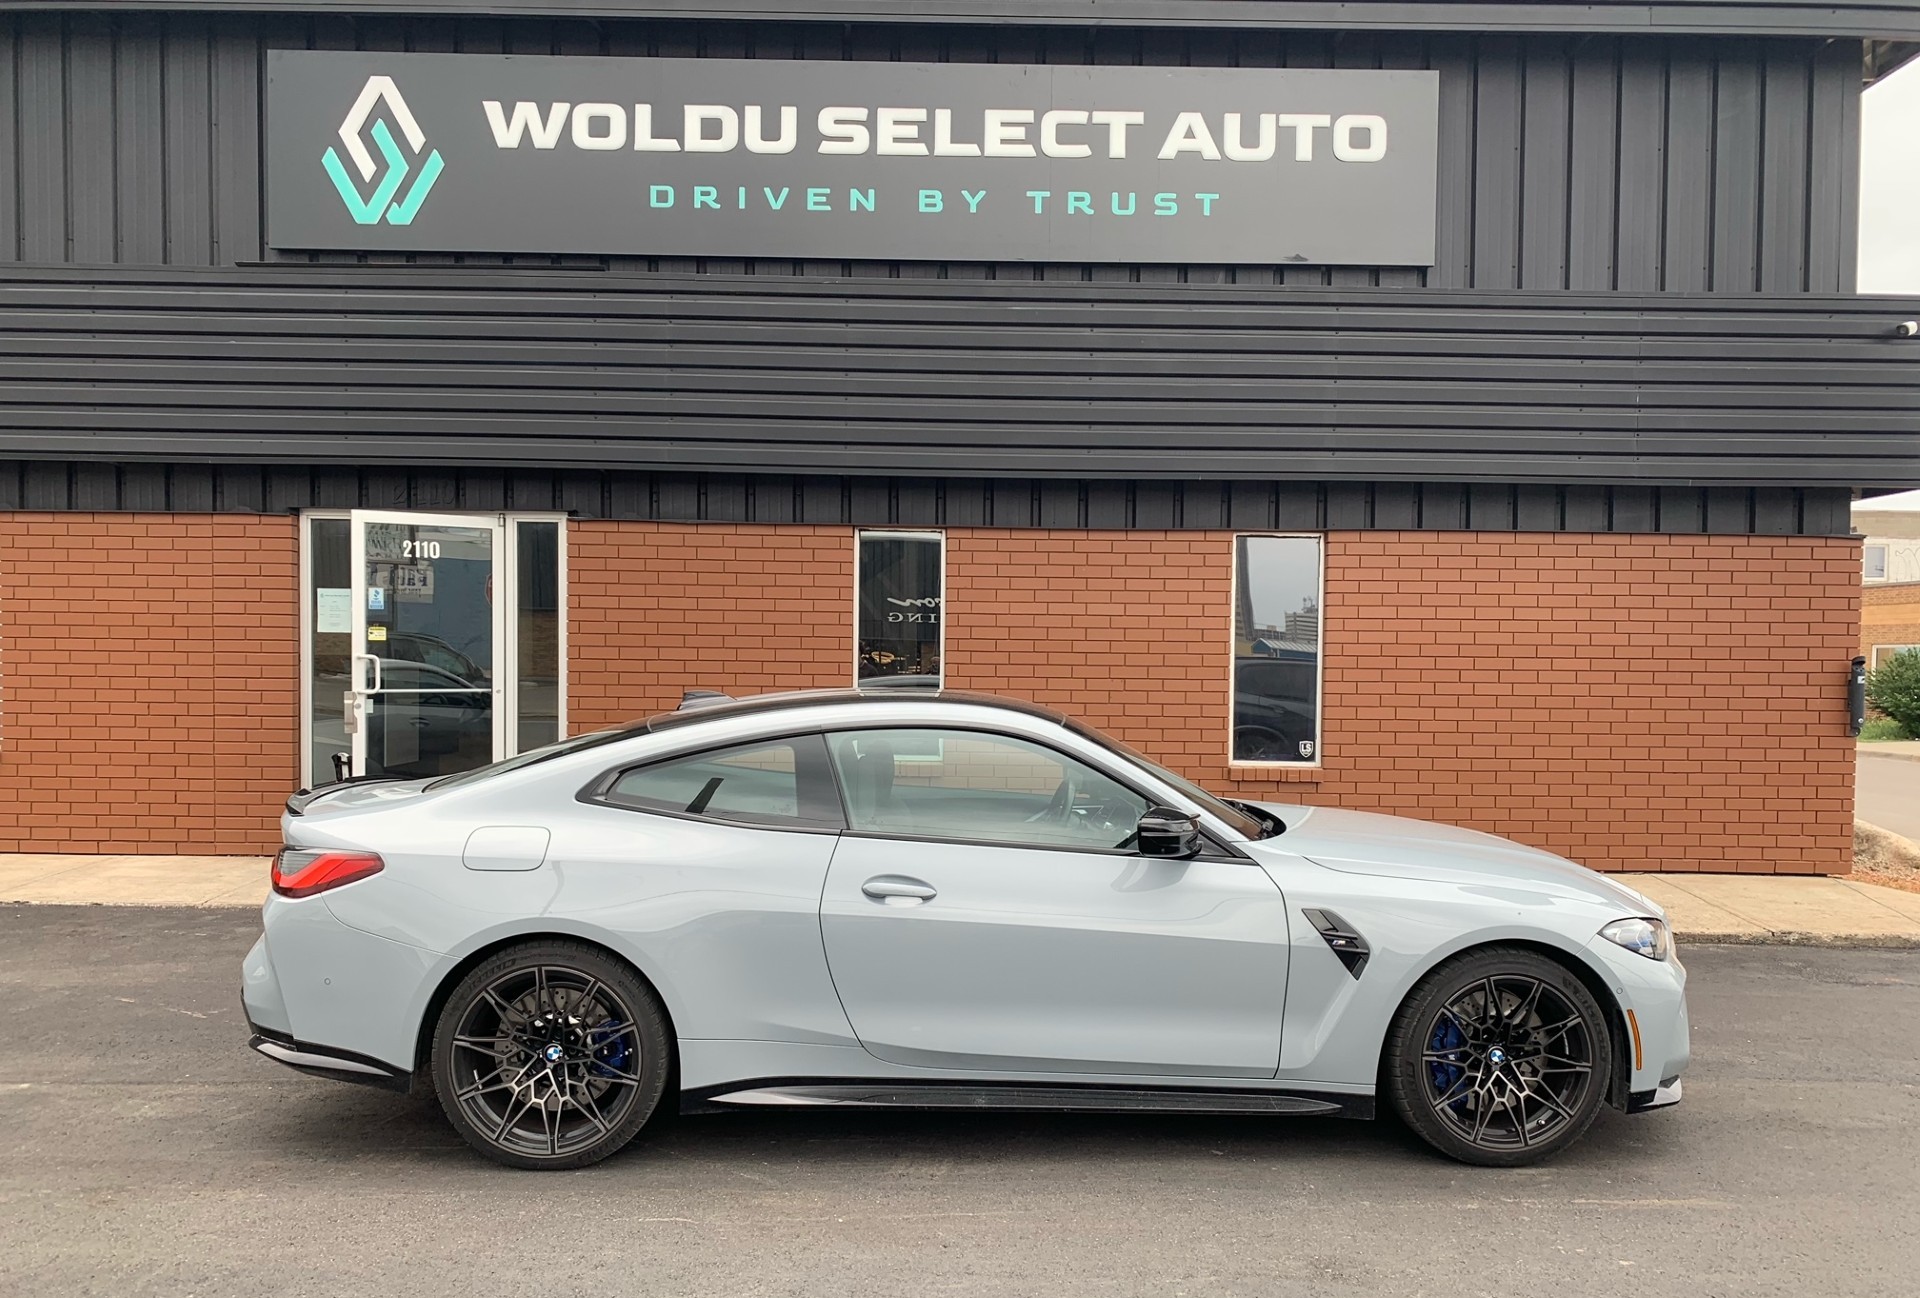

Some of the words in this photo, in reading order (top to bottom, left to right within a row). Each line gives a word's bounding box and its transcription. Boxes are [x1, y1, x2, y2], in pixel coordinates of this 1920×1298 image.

[482, 100, 798, 154] WOLDU
[817, 106, 1145, 159] SELECT
[1157, 111, 1388, 162] AUTO
[649, 185, 877, 212] DRIVEN
[918, 189, 986, 213] BY
[1027, 191, 1220, 217] TRUST
[402, 539, 440, 559] 2110
[1301, 743, 1312, 752] LS
